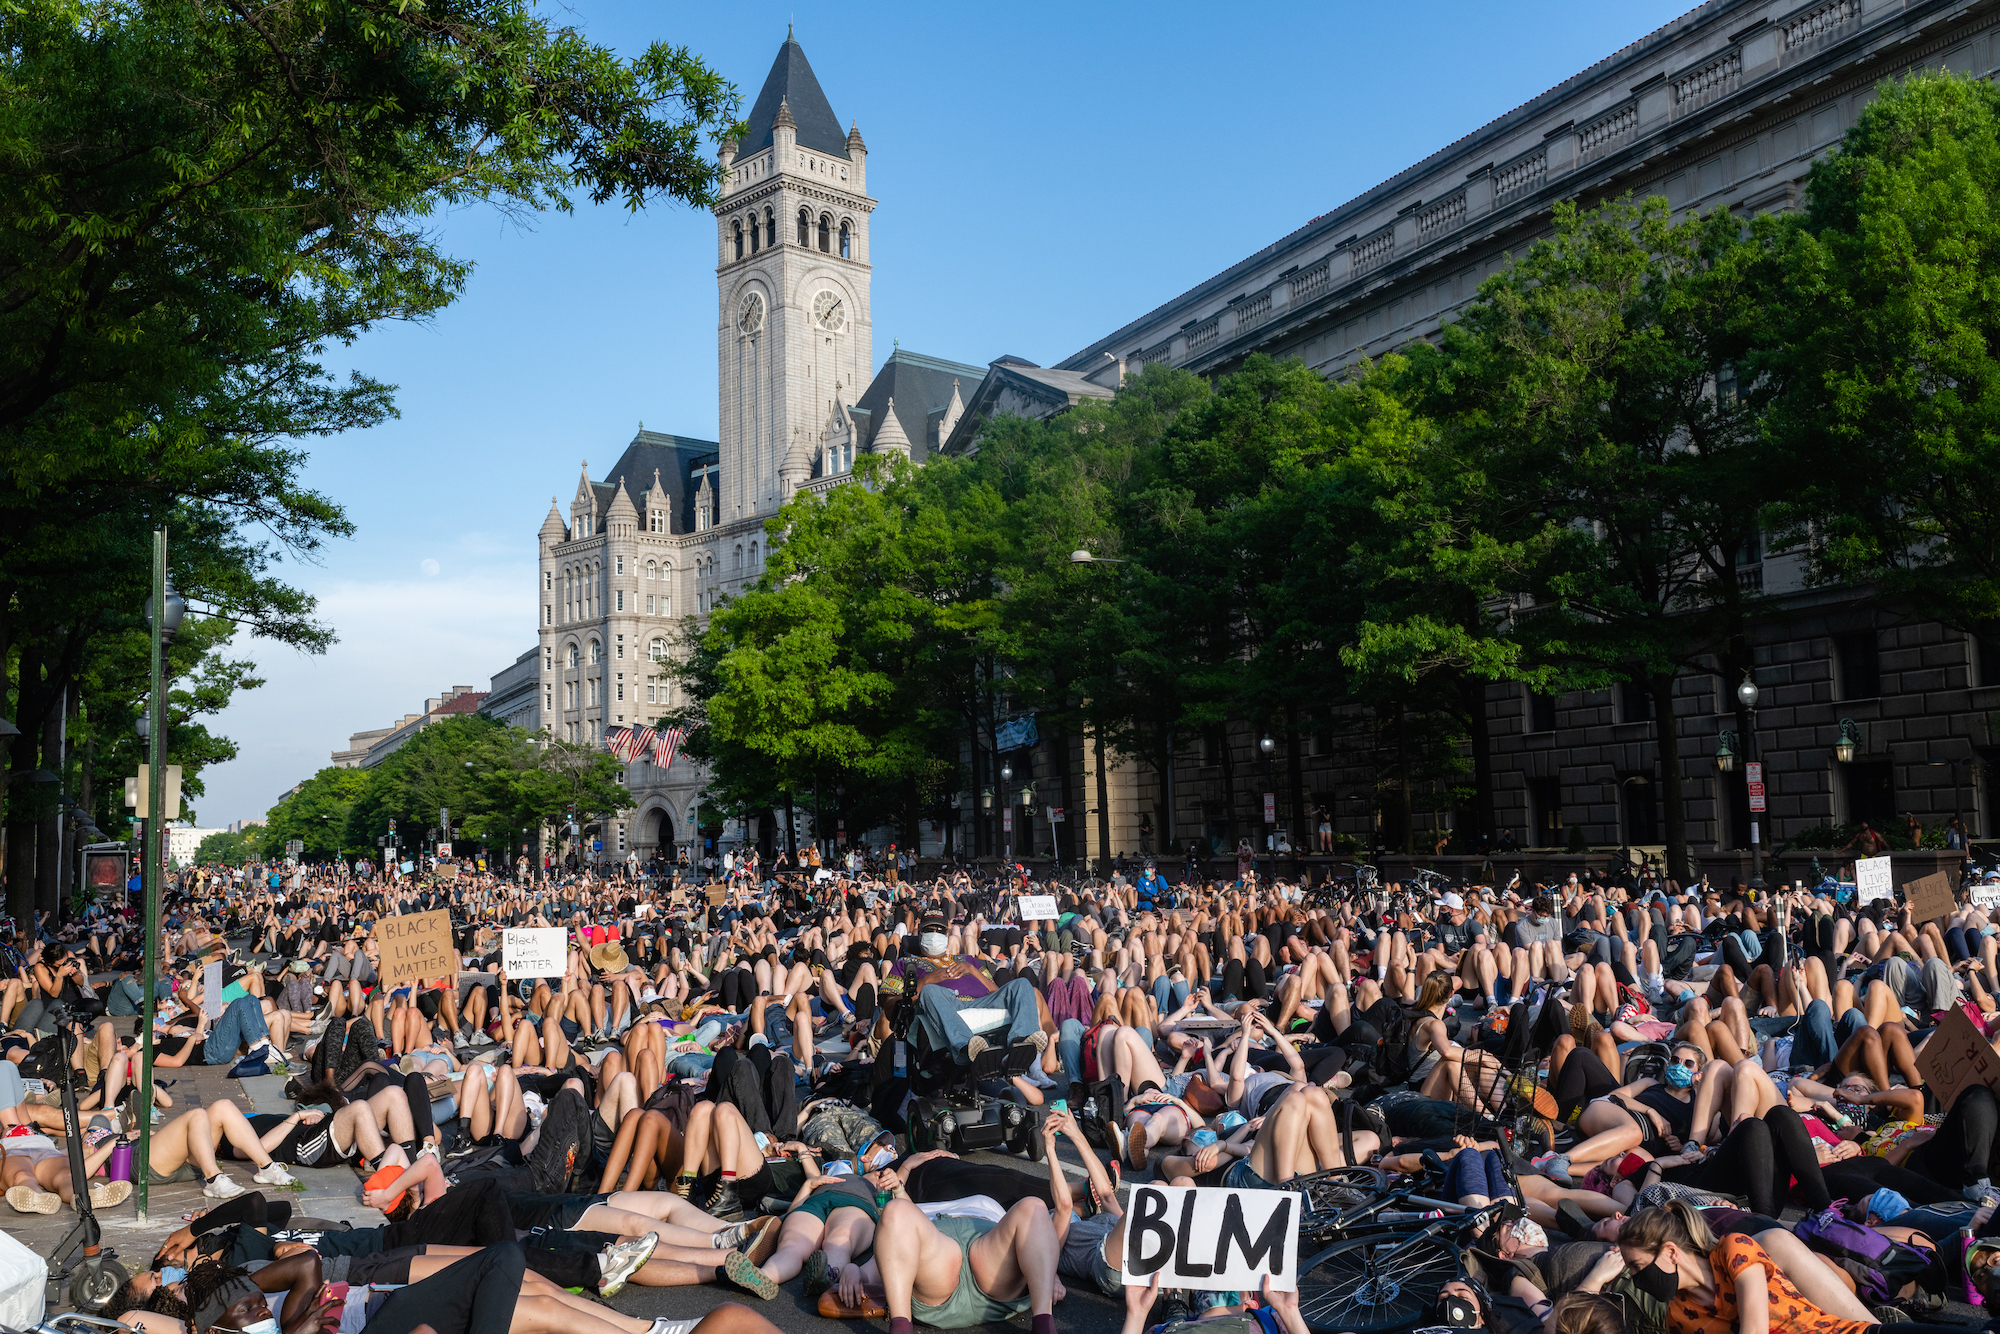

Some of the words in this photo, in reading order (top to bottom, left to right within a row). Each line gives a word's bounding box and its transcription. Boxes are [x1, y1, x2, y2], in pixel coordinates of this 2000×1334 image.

[1858, 860, 1891, 872] BLACK
[1864, 872, 1891, 885] LIVES
[1860, 883, 1892, 898] MATTER
[1911, 879, 1945, 902] SILENCE
[1912, 902, 1946, 916] VIOLENCE
[385, 918, 438, 940] BLACK
[507, 932, 538, 946] Black
[395, 940, 438, 959] LIVES
[516, 947, 540, 957] Lives
[393, 955, 447, 978] MATTER
[508, 959, 553, 971] MATTER
[1128, 1187, 1292, 1278] BLM
